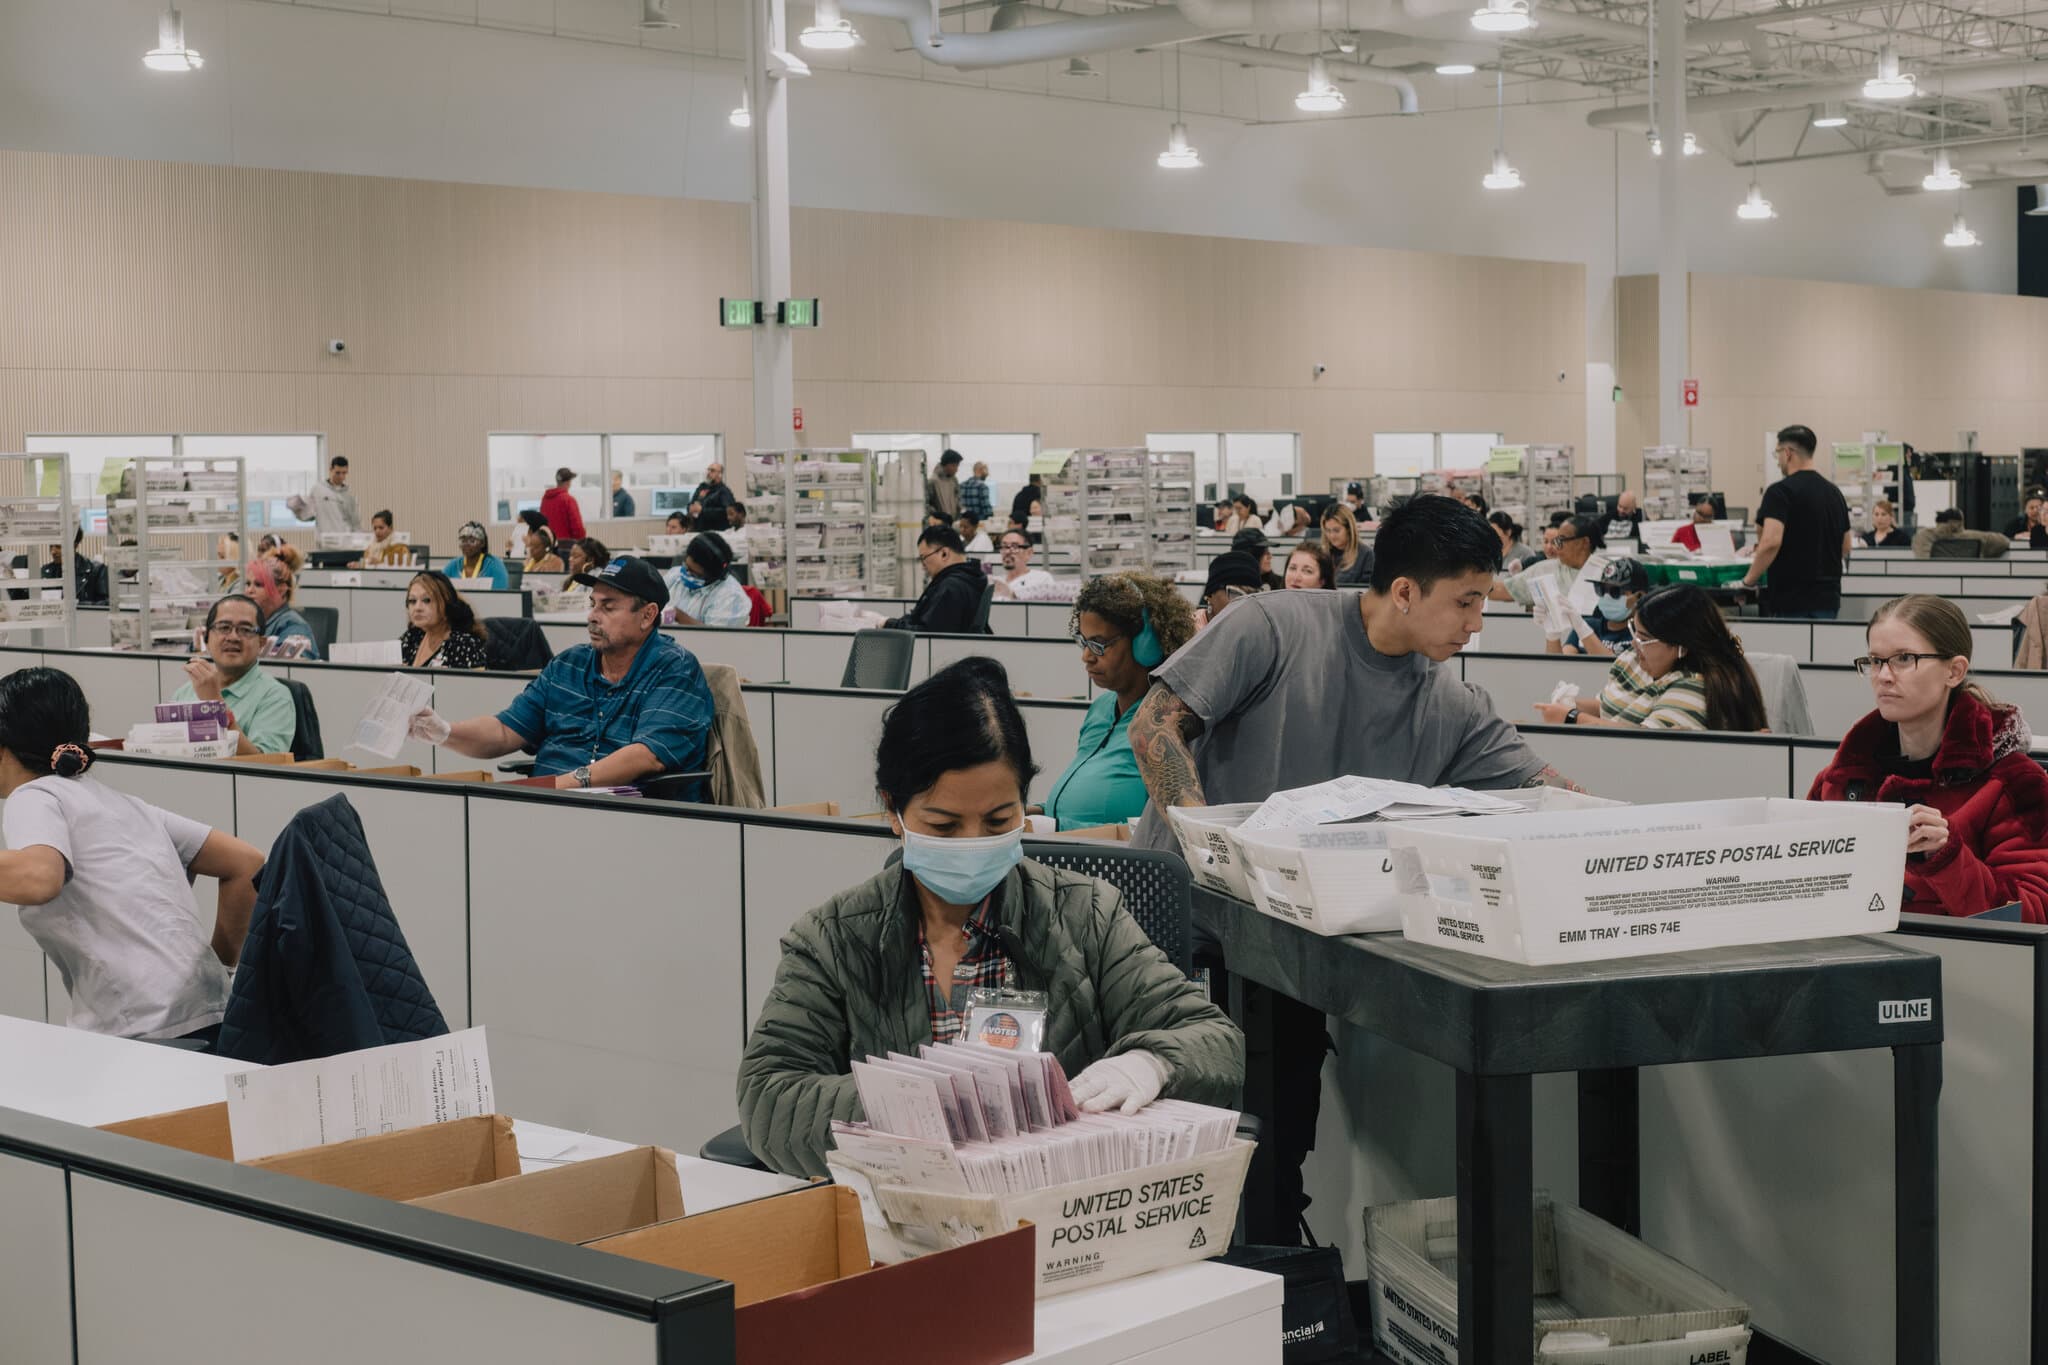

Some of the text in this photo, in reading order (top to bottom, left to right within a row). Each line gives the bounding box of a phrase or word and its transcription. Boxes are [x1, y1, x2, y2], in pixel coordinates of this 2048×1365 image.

[1205, 831, 1225, 844] LABEL
[1217, 854, 1230, 864] END
[1584, 837, 1857, 875] UNITED STATES POSTAL SERVICE
[1706, 875, 1740, 885] WARNING
[1437, 916, 1480, 932] UNITED STATES
[1559, 930, 1587, 943] EMM
[1590, 927, 1620, 941] TRAY
[1630, 923, 1657, 937] EIRS
[1660, 921, 1681, 934] 74E
[1438, 926, 1485, 943] POSTAL SERVICE
[1883, 1003, 1928, 1019] ULINE
[988, 1026, 1018, 1037] VOTED
[1062, 1172, 1204, 1218] UNITED STATES
[1051, 1194, 1214, 1248] POSTAL SERVICE
[1046, 1252, 1100, 1270] WARNING
[1383, 1284, 1406, 1312] UNITED
[1406, 1302, 1432, 1331] STATES
[1432, 1320, 1458, 1351] POSTA
[1282, 1323, 1315, 1340] ancial
[1689, 1350, 1731, 1365] LABEL
